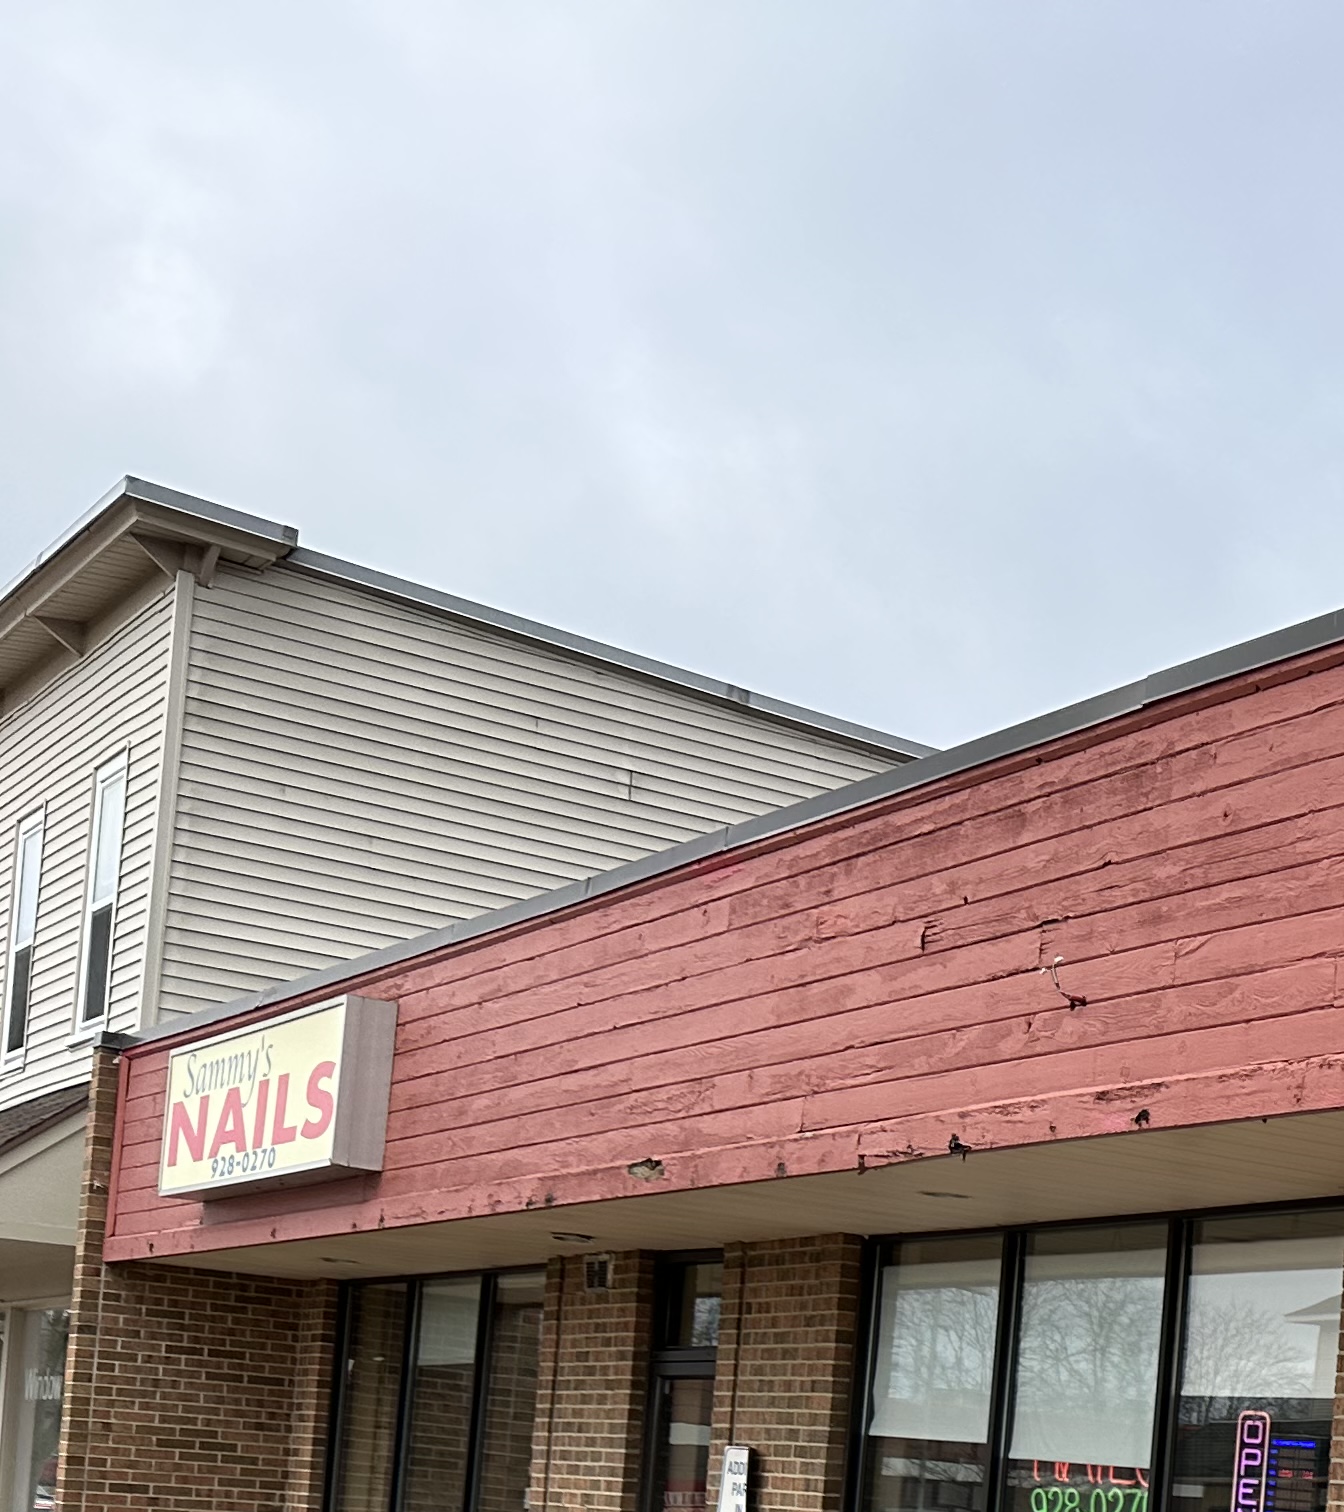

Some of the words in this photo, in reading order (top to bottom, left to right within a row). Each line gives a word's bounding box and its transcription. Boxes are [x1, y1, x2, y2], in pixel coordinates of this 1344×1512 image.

[183, 1034, 273, 1108] Sammy's
[167, 1060, 337, 1167] NAILS
[211, 1147, 276, 1178] 928-0270
